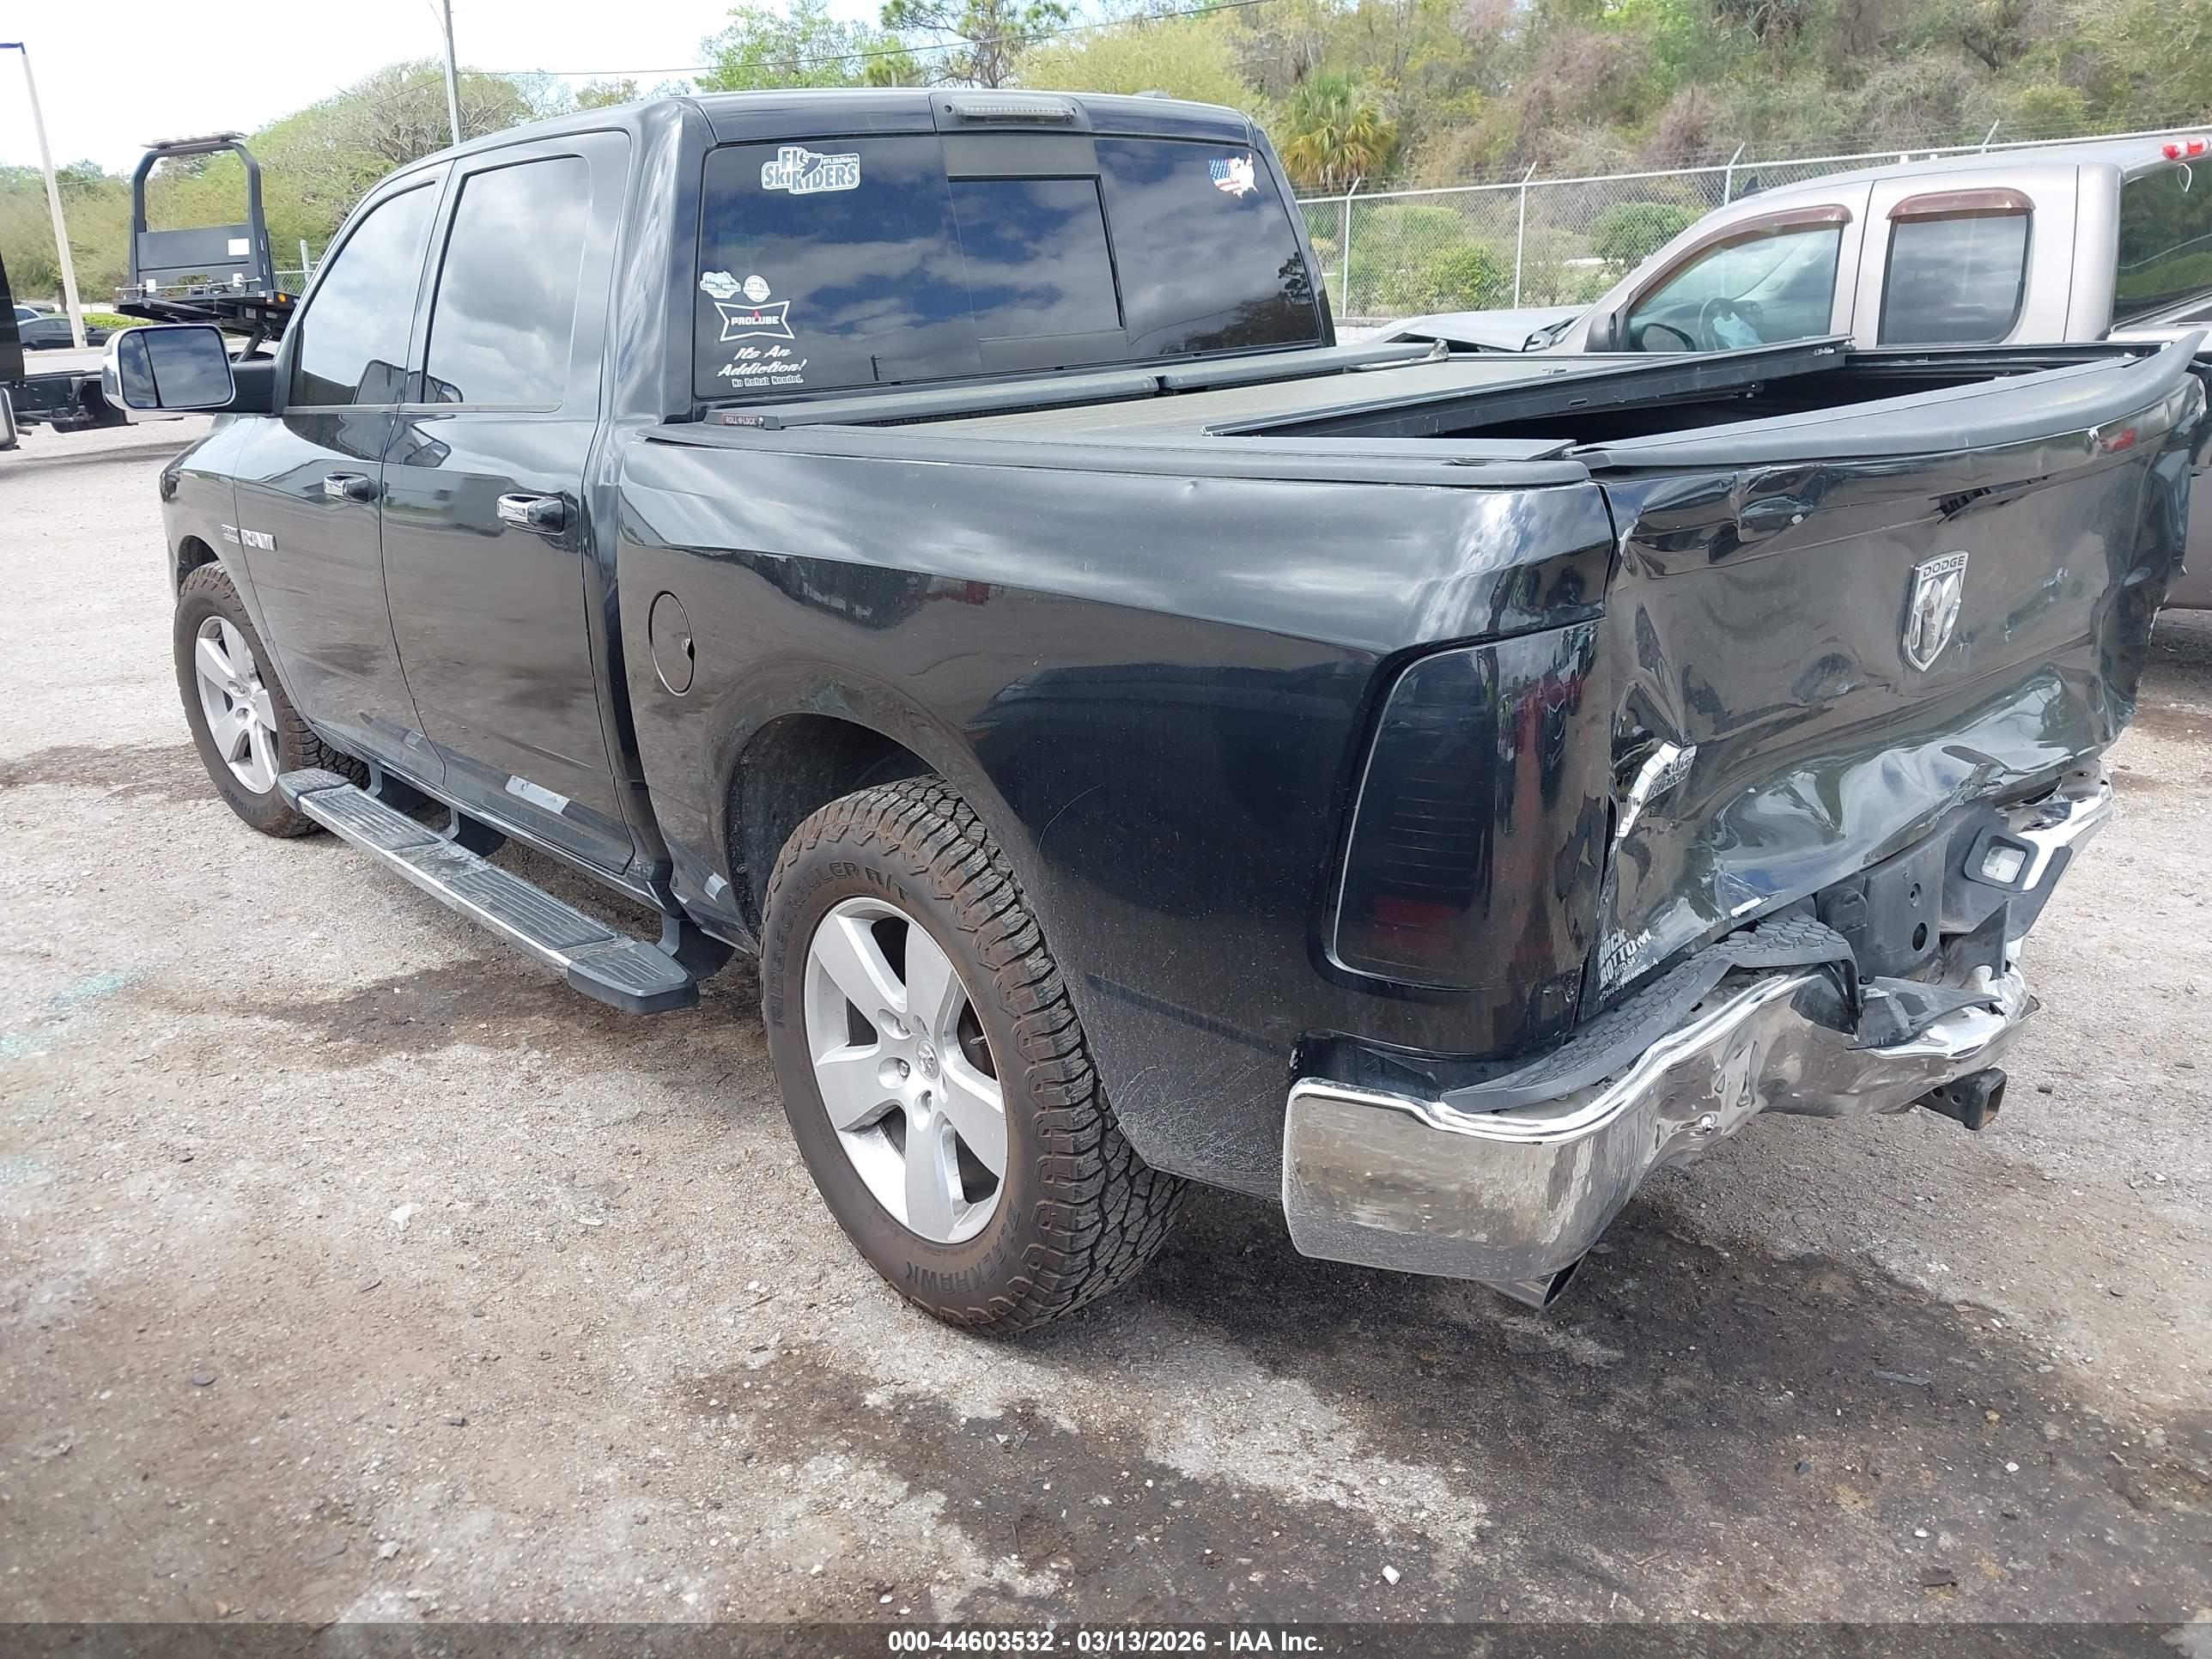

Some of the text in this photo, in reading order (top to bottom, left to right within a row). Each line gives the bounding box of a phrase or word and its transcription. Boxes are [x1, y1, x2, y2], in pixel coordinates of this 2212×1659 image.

[792, 165, 857, 191] RIDERS
[731, 315, 780, 326] PROLUBE
[763, 344, 792, 359] An
[716, 358, 808, 377] Addiction!
[732, 378, 744, 388] No
[744, 376, 771, 387] Rehab
[240, 528, 276, 551] RAM
[1923, 556, 1965, 577] DODGE
[1598, 928, 1627, 969] ROCK
[1599, 928, 1652, 990] BOTTOM
